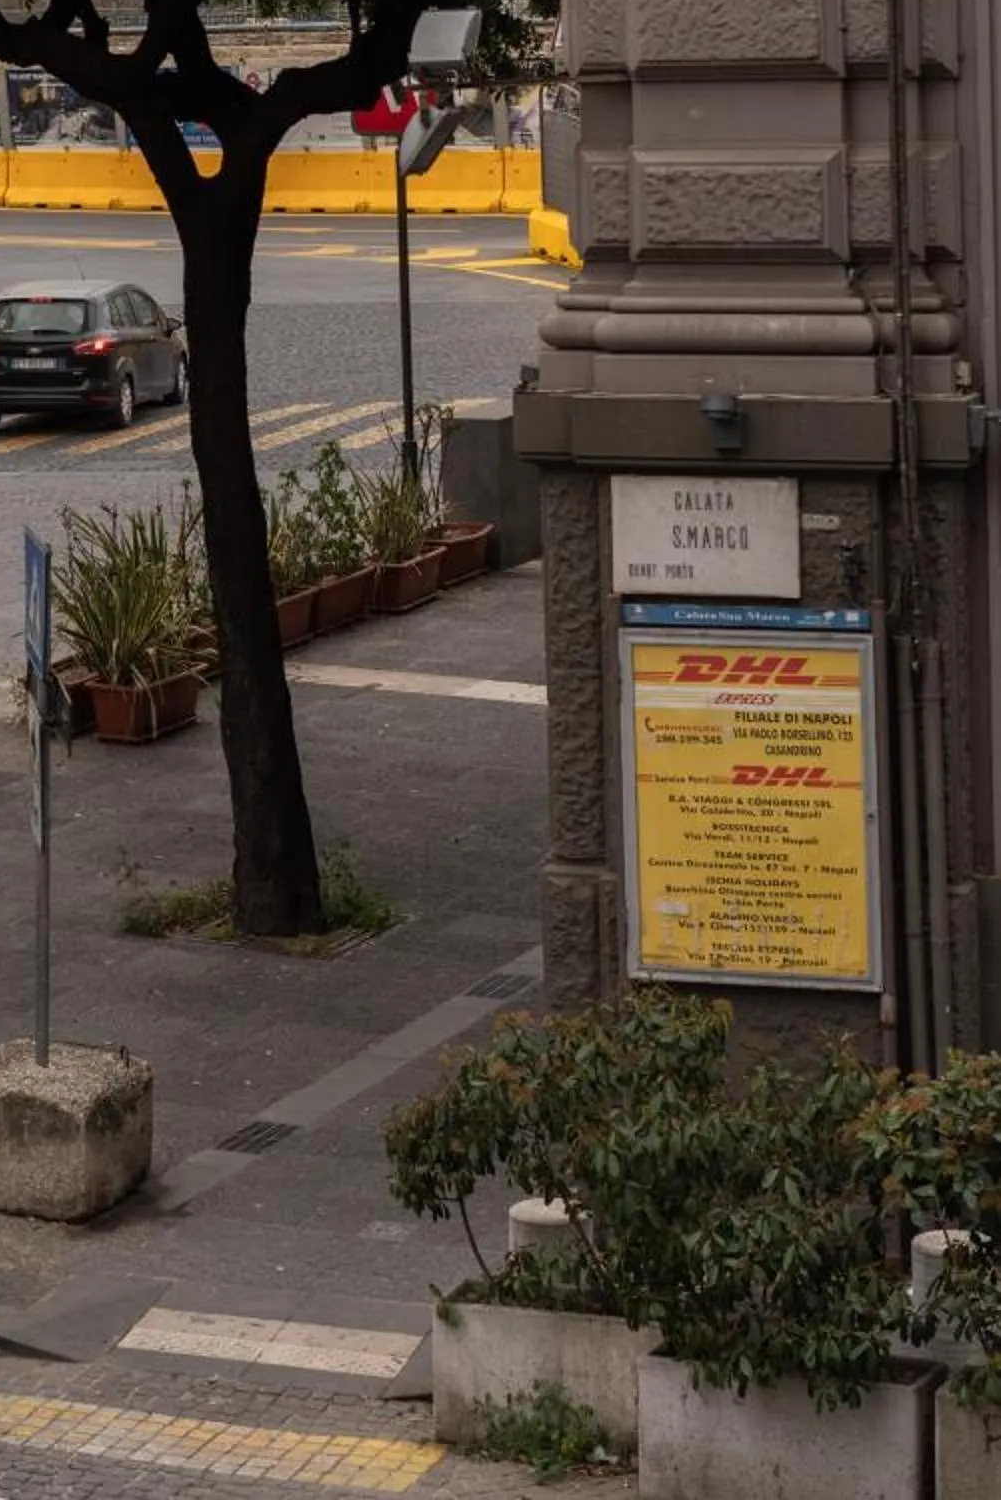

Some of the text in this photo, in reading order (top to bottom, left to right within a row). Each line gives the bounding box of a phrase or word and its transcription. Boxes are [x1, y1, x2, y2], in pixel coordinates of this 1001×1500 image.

[674, 491, 734, 511] CALATA
[672, 655, 817, 686] DHL
[713, 692, 780, 706] EXPRESS
[734, 711, 852, 725] FILIALE DI NAPOLI
[732, 727, 747, 739] VIA
[750, 728, 778, 740] PAOLO
[730, 765, 833, 788] DHL
[692, 795, 734, 805] VIAGGI
[747, 797, 810, 807] CONGRESSI
[680, 805, 698, 813] Via
[785, 810, 822, 819] Napoli
[683, 832, 701, 840] Via
[714, 851, 788, 862] TEAM SERVICE
[820, 865, 858, 876] Napoli
[706, 876, 800, 889] ISCHIA HOLIDAYS
[678, 919, 695, 929] Via
